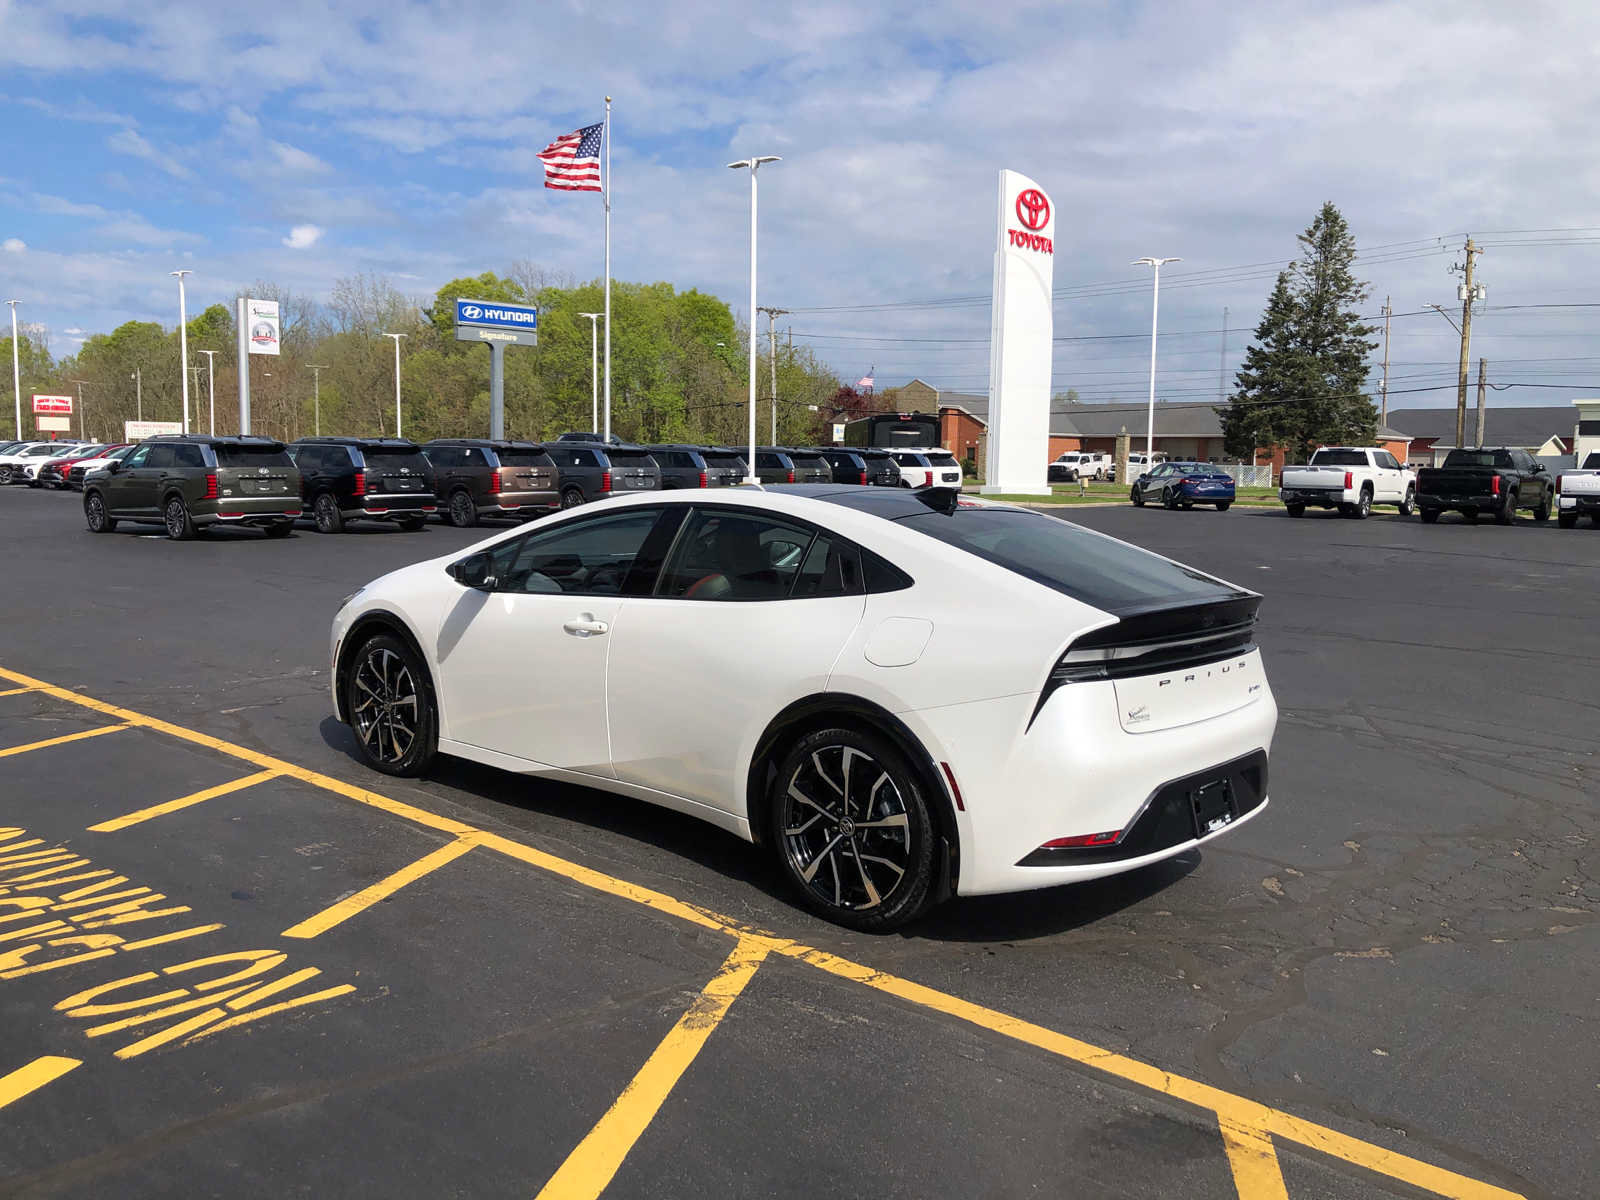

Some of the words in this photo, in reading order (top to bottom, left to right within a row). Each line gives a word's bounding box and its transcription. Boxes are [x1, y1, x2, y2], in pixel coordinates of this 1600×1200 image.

[1008, 228, 1053, 256] TOYOTA
[484, 308, 534, 323] HYUNDAI
[1159, 661, 1246, 687] PRIUS
[52, 949, 357, 1060] NO
